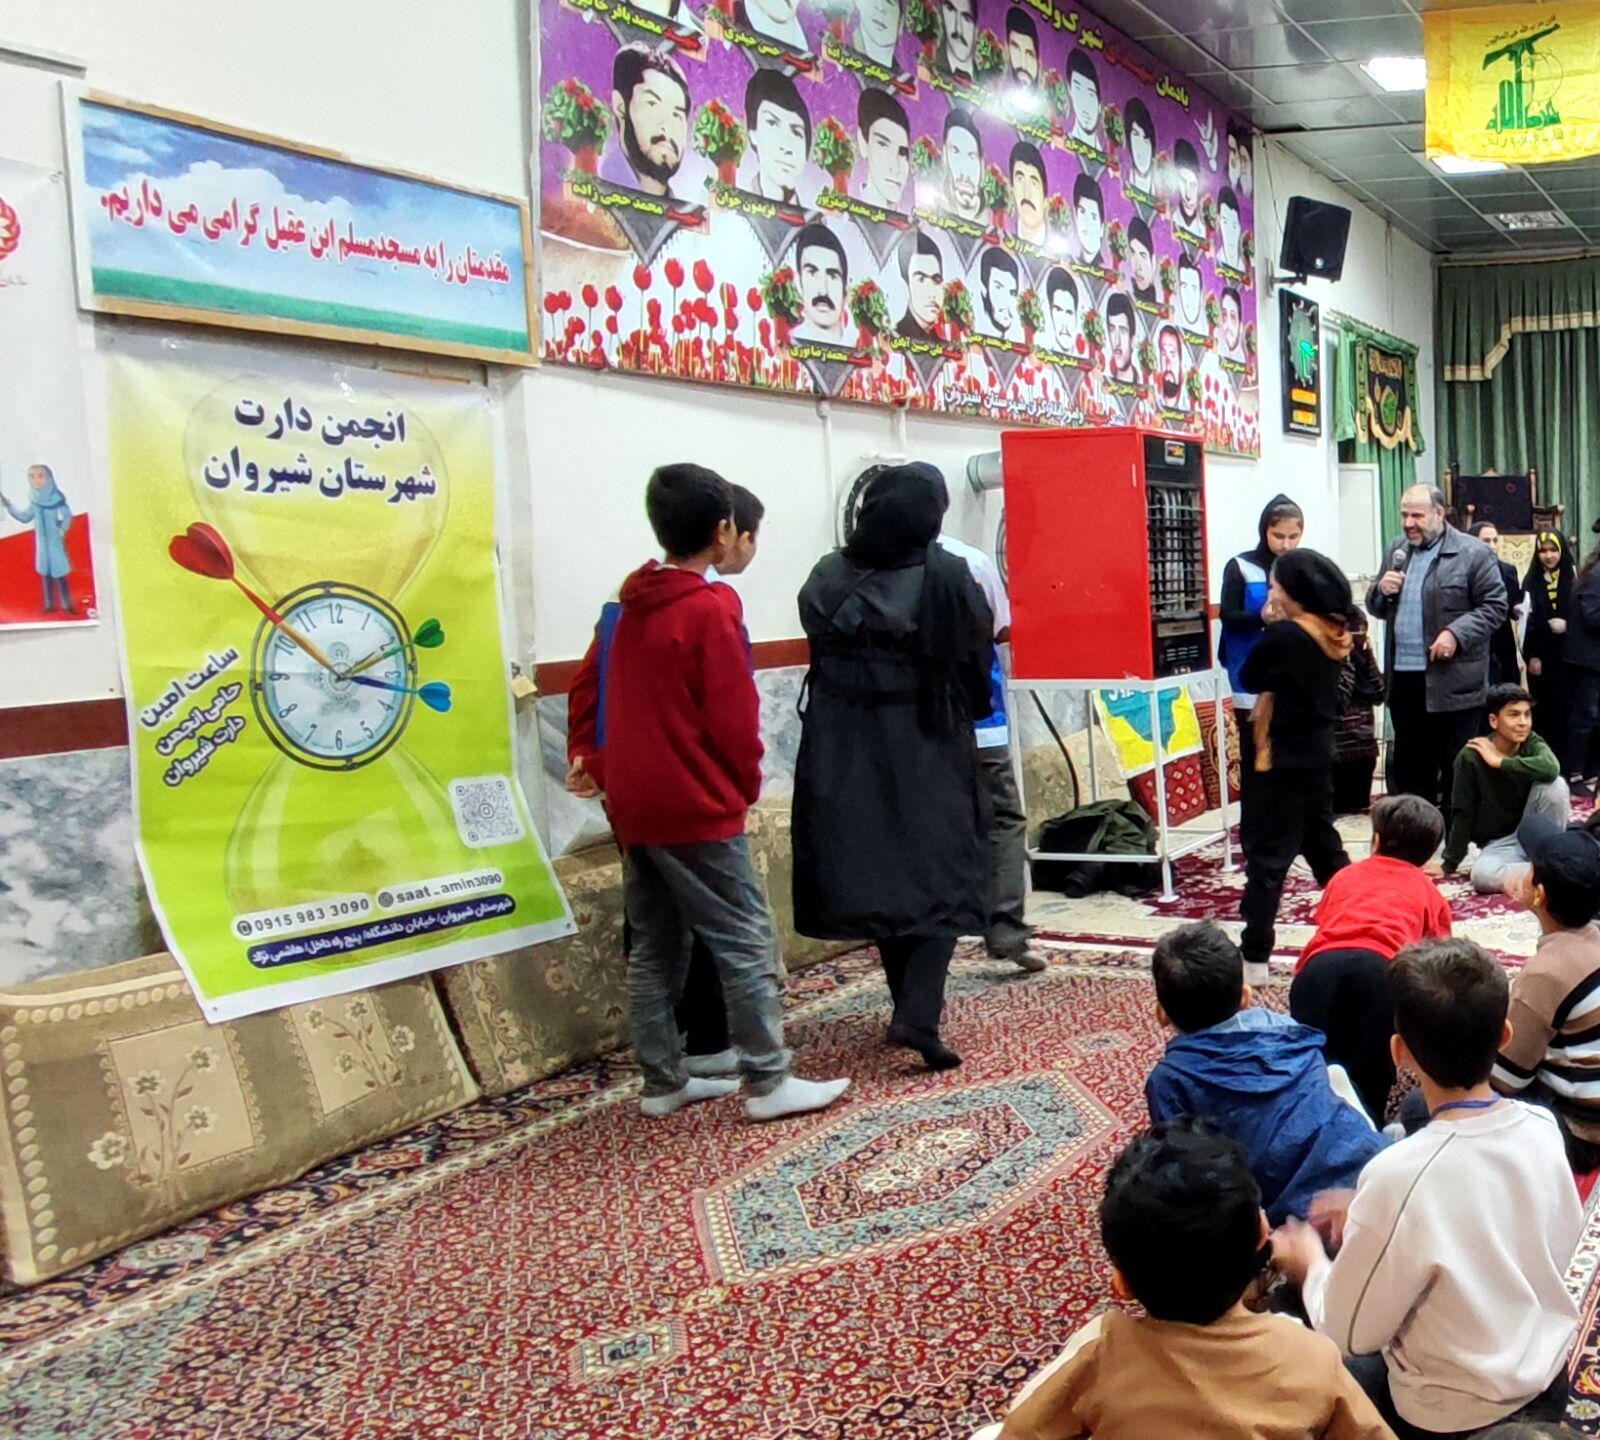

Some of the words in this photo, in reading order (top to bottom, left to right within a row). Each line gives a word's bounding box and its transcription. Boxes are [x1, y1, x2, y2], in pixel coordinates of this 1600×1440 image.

[632, 14, 664, 35] محمد
[600, 193, 631, 208] حجی
[632, 197, 664, 215] محمد
[743, 198, 777, 218] فریدون
[168, 204, 199, 234] می
[203, 198, 261, 246] گرامی
[265, 206, 306, 250] عقیل
[311, 218, 335, 259] ابن
[456, 247, 509, 284] مقدمتان
[826, 350, 848, 362] محمد
[944, 384, 982, 407] شیروان
[234, 397, 312, 440] دارت
[322, 411, 405, 449] انجمن
[204, 445, 313, 493] شیروان
[319, 456, 436, 503] شهرستان
[296, 610, 318, 633] 11
[329, 603, 344, 624] 12
[360, 613, 371, 631] 1
[274, 634, 298, 656] 10
[185, 648, 239, 690] ساعت
[269, 672, 291, 682] 9
[384, 670, 402, 679] 3
[140, 681, 186, 728] امین
[279, 703, 298, 718] 8
[377, 699, 395, 712] 4
[156, 707, 206, 755] انجمن
[212, 716, 245, 745] دارت
[304, 723, 318, 743] 7
[335, 729, 343, 751] 6
[359, 720, 374, 740] 5
[164, 736, 216, 786] شیروان
[254, 913, 293, 932] 0915
[296, 907, 326, 924] 983
[329, 898, 370, 918] 3090
[474, 897, 513, 918] شهرستان
[405, 914, 436, 934] خیابان
